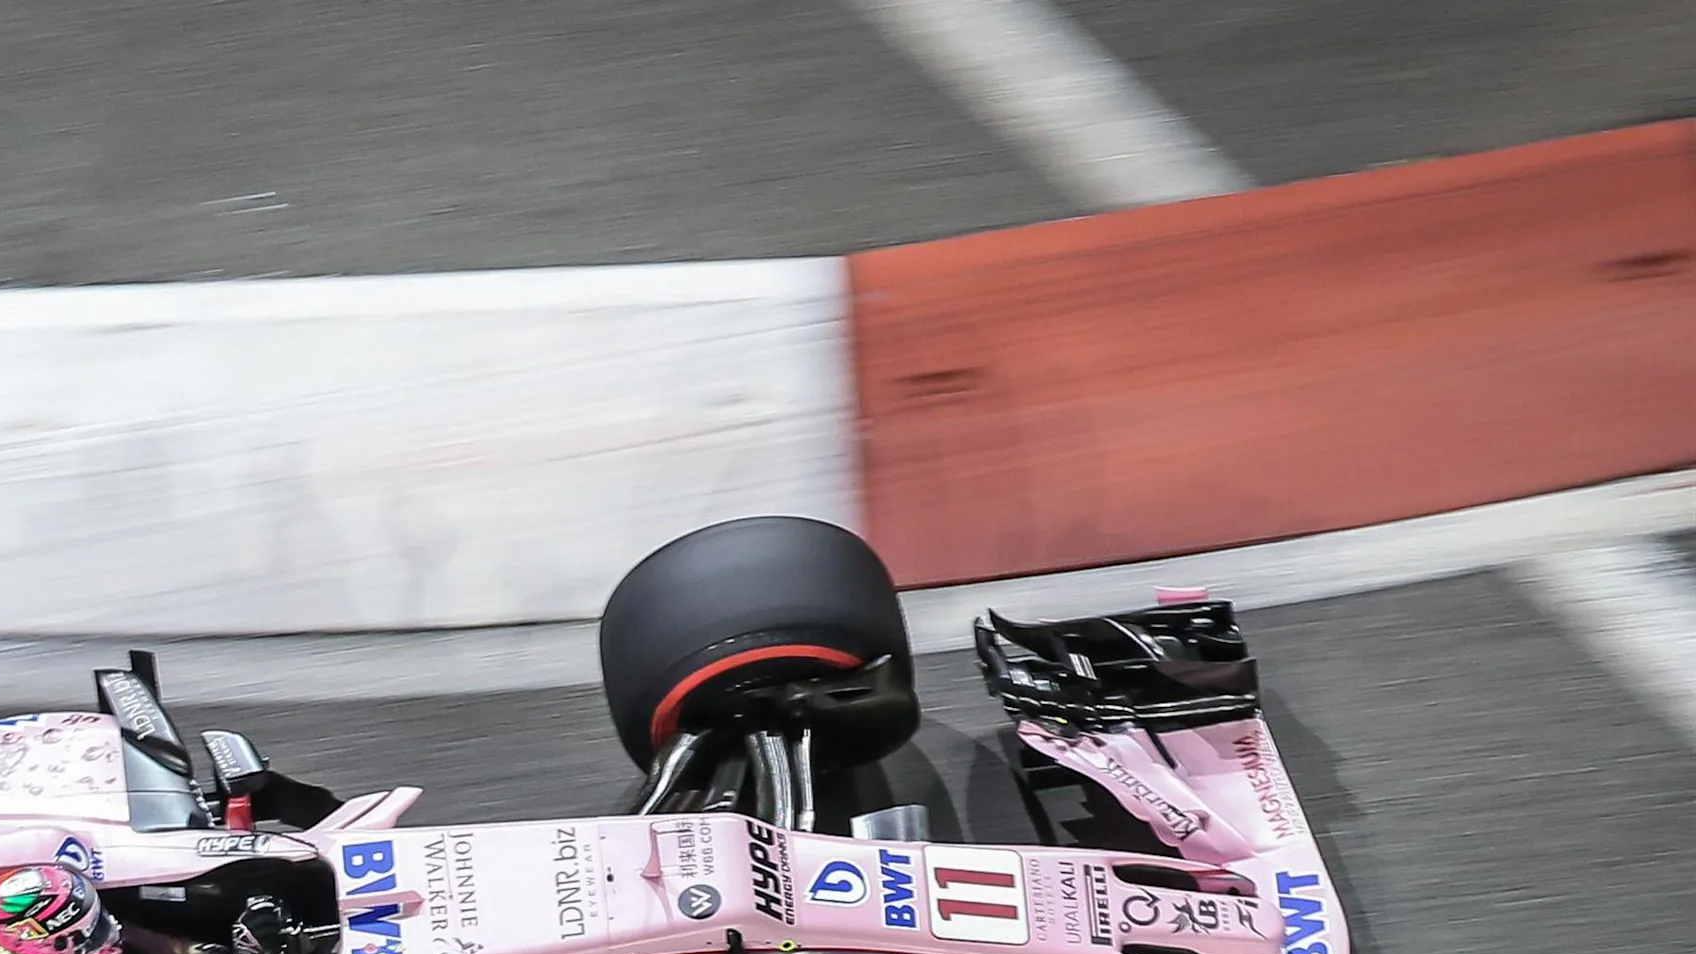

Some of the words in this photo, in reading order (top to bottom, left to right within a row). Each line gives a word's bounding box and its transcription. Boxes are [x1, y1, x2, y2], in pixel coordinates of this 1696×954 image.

[199, 835, 253, 852] HYPE
[423, 832, 449, 932] WALKER
[447, 832, 479, 928] JOHNNIE
[551, 826, 586, 940] LDNR.biz
[583, 843, 599, 918] EYEWEAR
[746, 819, 784, 923] HYPE
[46, 901, 81, 931] NEC
[780, 875, 796, 926] ENERGY
[879, 848, 917, 929] BWT
[934, 866, 1019, 923] 11
[1058, 860, 1082, 945] URALKALI
[1082, 863, 1114, 947] PIRELLI
